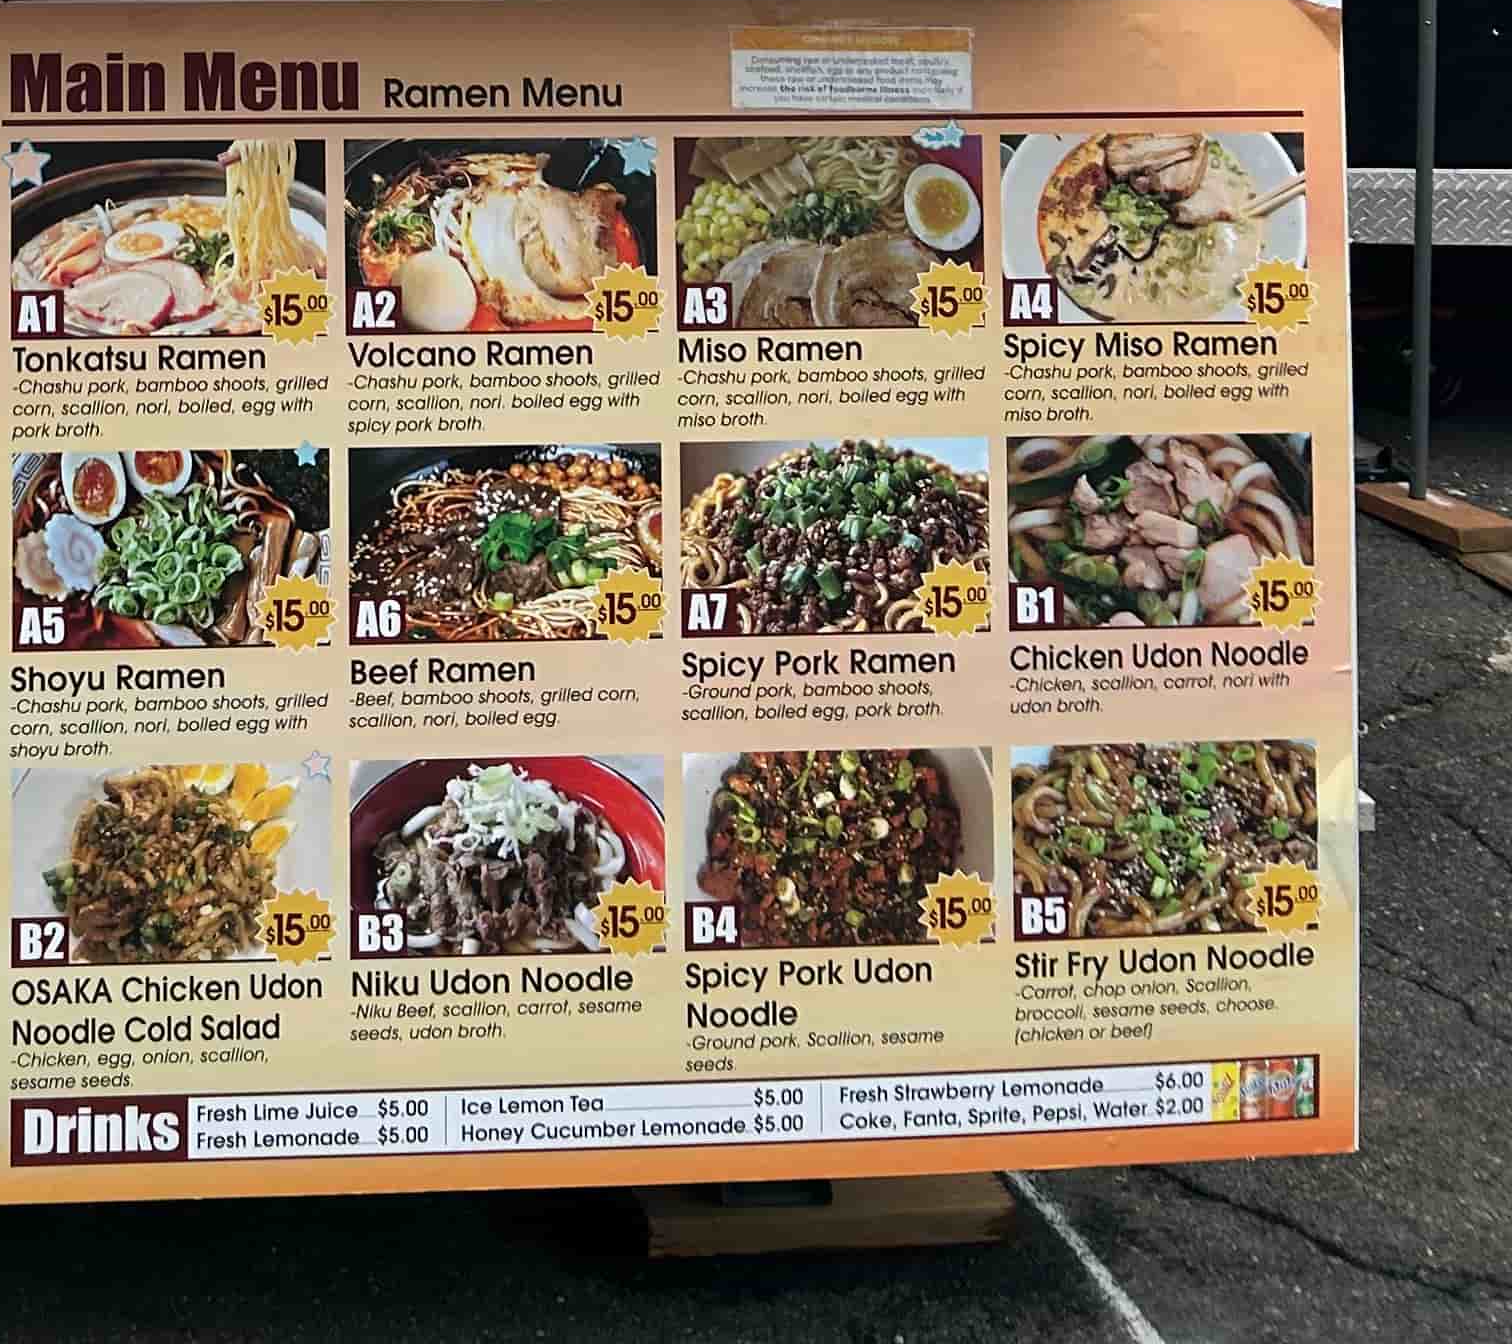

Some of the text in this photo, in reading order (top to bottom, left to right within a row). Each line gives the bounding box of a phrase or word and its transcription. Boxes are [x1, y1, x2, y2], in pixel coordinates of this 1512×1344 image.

[9, 51, 360, 113] Main Menu
[383, 76, 623, 109] Ramen Menu
[18, 295, 57, 334] A1
[1009, 284, 1053, 321] A4
[12, 344, 266, 374] Tonkatsu Ramen
[347, 340, 593, 369] Volcano Ramen
[678, 336, 863, 364] Miso Ramen
[1003, 330, 1278, 364] Spicy Miso Ramen
[87, 377, 129, 397] pork,
[135, 377, 209, 393] bamboo
[212, 375, 269, 393] shoots,
[275, 375, 329, 395] grilled
[677, 412, 716, 428] miso
[1017, 589, 1056, 625] B1
[350, 657, 535, 685] Beef Ramen
[681, 648, 956, 684] Spicy Pork Ramen
[1009, 639, 1309, 672] Chicken Udon Noodle
[10, 664, 225, 698] Shoyu Ramen
[400, 690, 474, 706] bamboo
[477, 688, 534, 705] shoots,
[540, 687, 594, 707] grilled
[597, 688, 640, 703] corn,
[685, 957, 933, 995] Spicy Pork Udon
[1015, 941, 1315, 984] Stir Fry Udon Noodle
[11, 972, 323, 1006] OSAKA Chicken Udon
[351, 964, 634, 998] Niku Udon Noodle
[12, 1012, 281, 1046] Noodle Cold Salad
[687, 999, 799, 1029] Noodle
[1088, 1027, 1107, 1040] or
[839, 1085, 888, 1105] Fresh
[893, 1081, 996, 1102] Strawberry
[1001, 1076, 1104, 1097] Lemonade
[1155, 1071, 1204, 1092] $6.00
[197, 1099, 429, 1123] Fresh Lime Juice $5.00
[839, 1097, 1204, 1131] Coke, Fanta, Sprite, Pepsi, Water $2.00
[23, 1107, 180, 1156] Drinks
